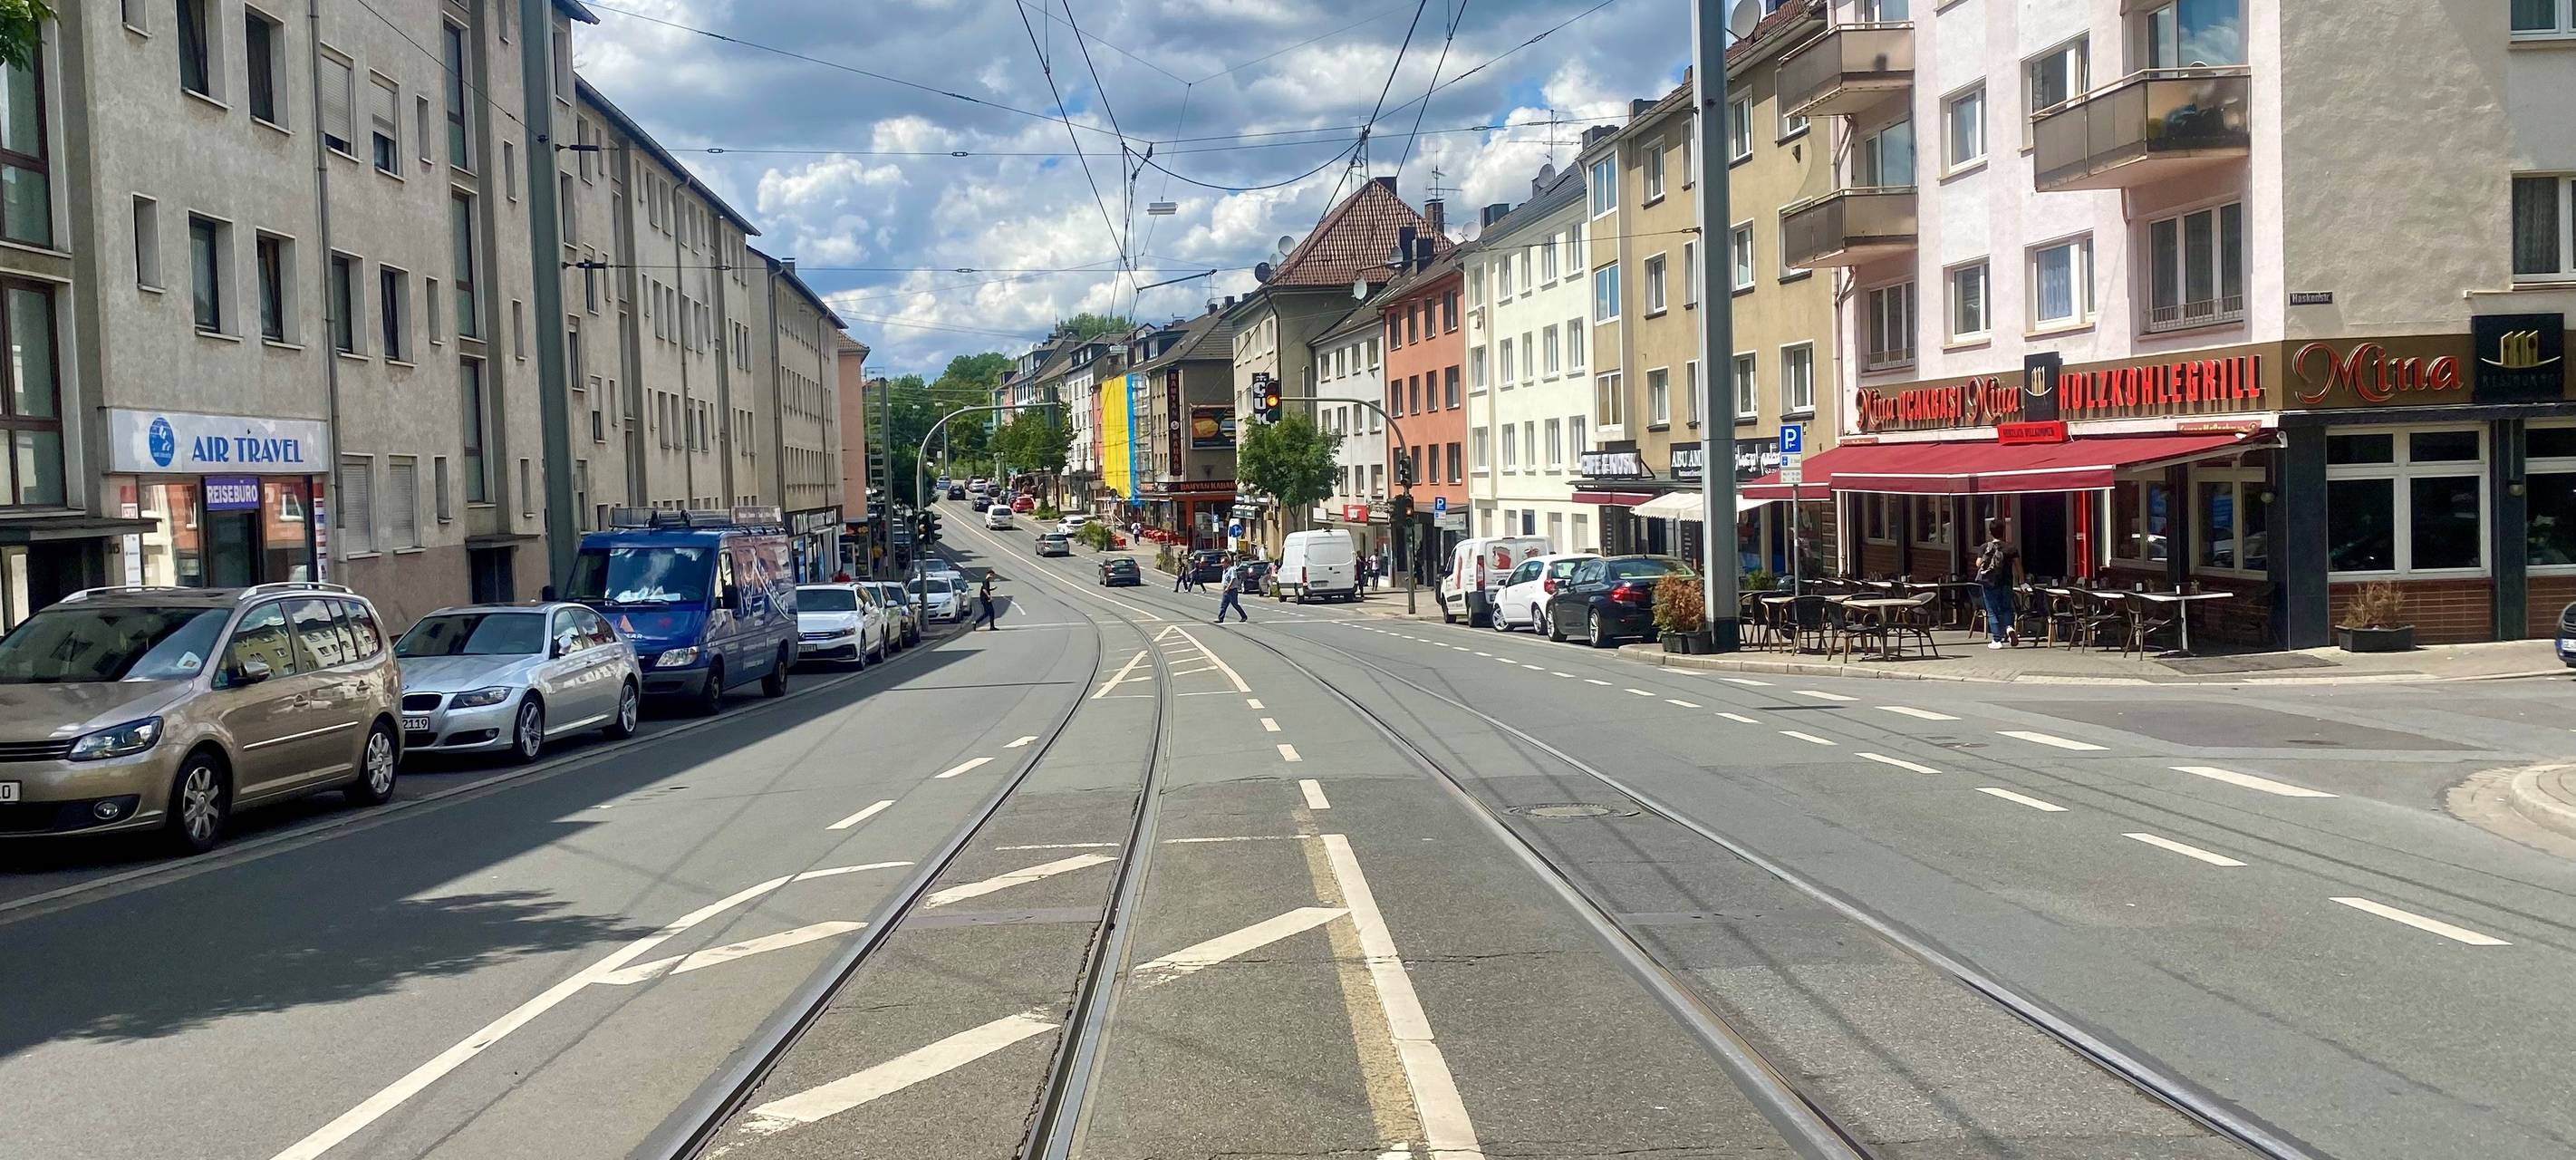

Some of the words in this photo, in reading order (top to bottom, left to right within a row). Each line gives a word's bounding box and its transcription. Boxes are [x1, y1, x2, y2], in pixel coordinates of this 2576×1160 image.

[2059, 354, 2263, 411] HOLZKOHLEGRILL
[2292, 342, 2465, 404] Mina
[1856, 388, 1896, 429] Mina
[1966, 376, 2023, 421] Mina
[191, 435, 229, 462] AIR
[234, 436, 304, 464] TRAVEL
[1671, 450, 1688, 468] ABU
[206, 479, 259, 504] REISEBÜRO
[402, 719, 428, 730] 2119
